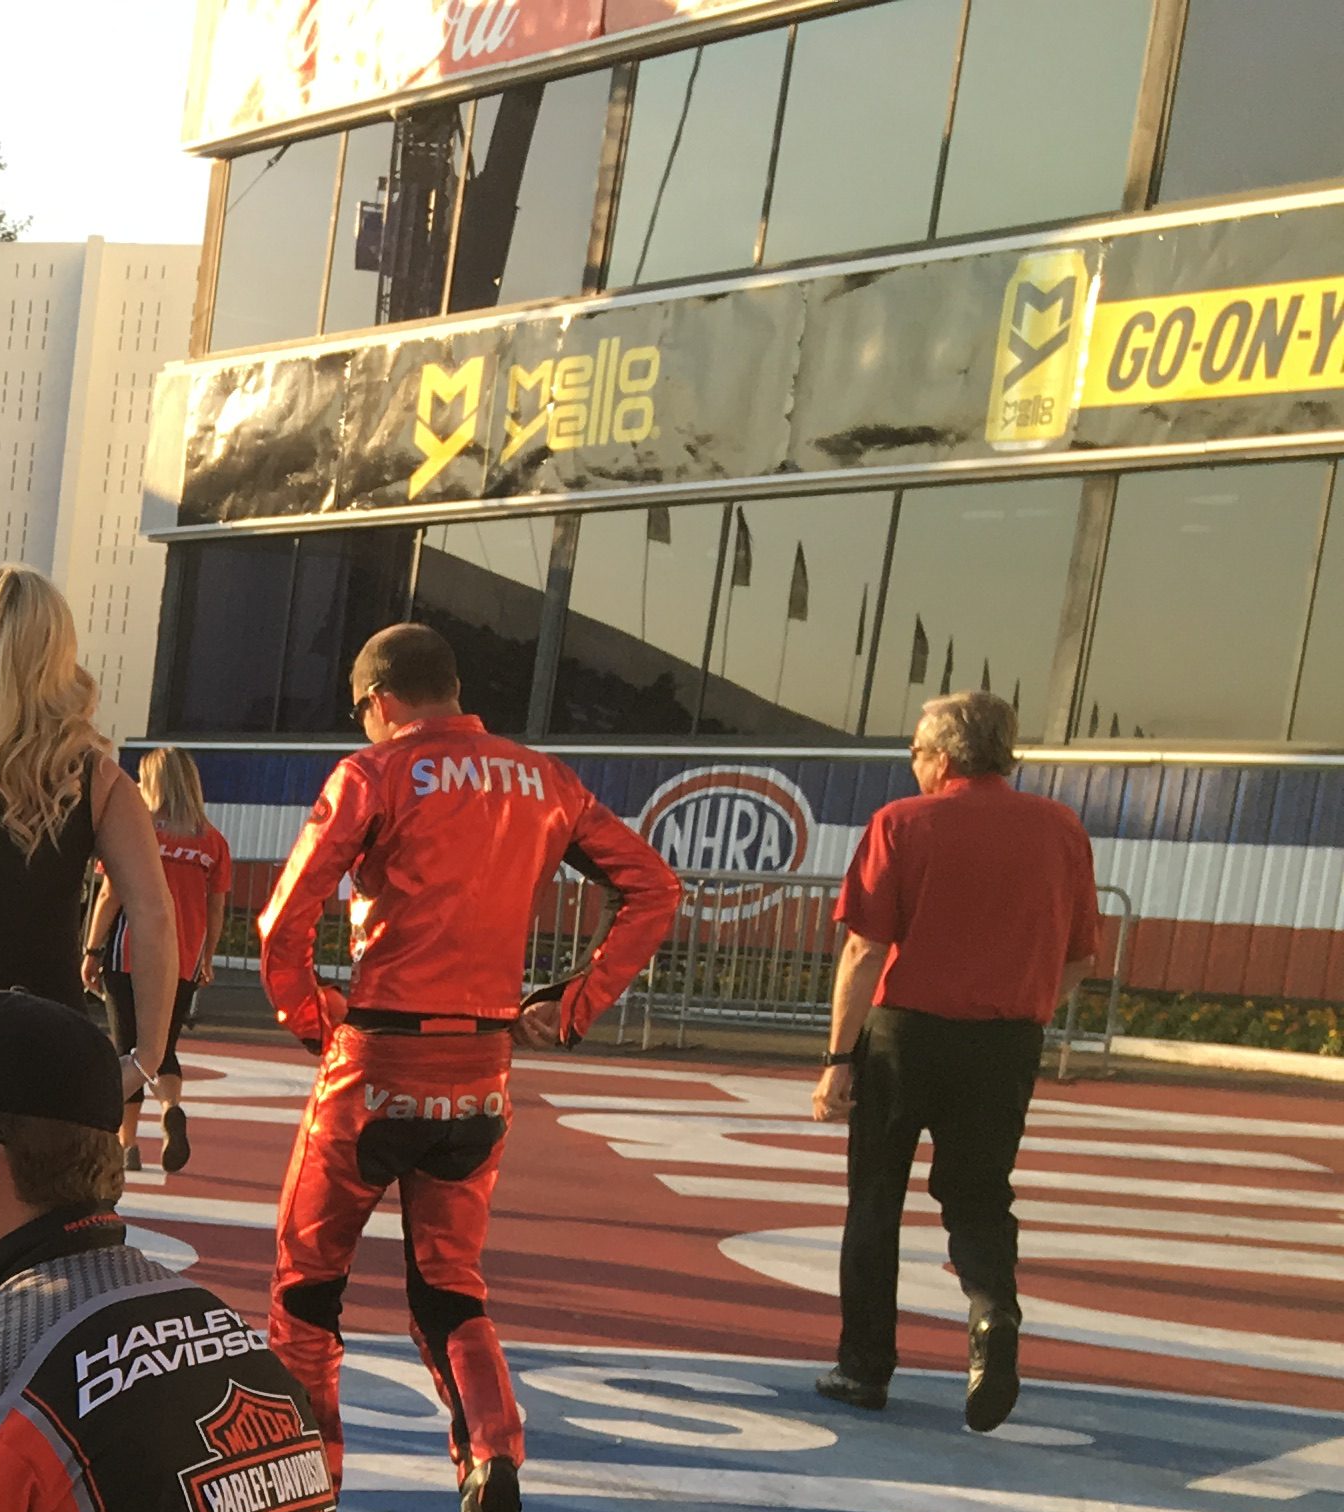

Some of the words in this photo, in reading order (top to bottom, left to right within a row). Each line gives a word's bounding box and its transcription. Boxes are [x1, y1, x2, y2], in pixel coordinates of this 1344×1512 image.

[1106, 291, 1344, 392] GO-ON-Y
[411, 755, 545, 801] SMITH
[663, 797, 781, 872] NHRA
[76, 1330, 270, 1419] DAVIDSO
[226, 1403, 302, 1452] MOTOR
